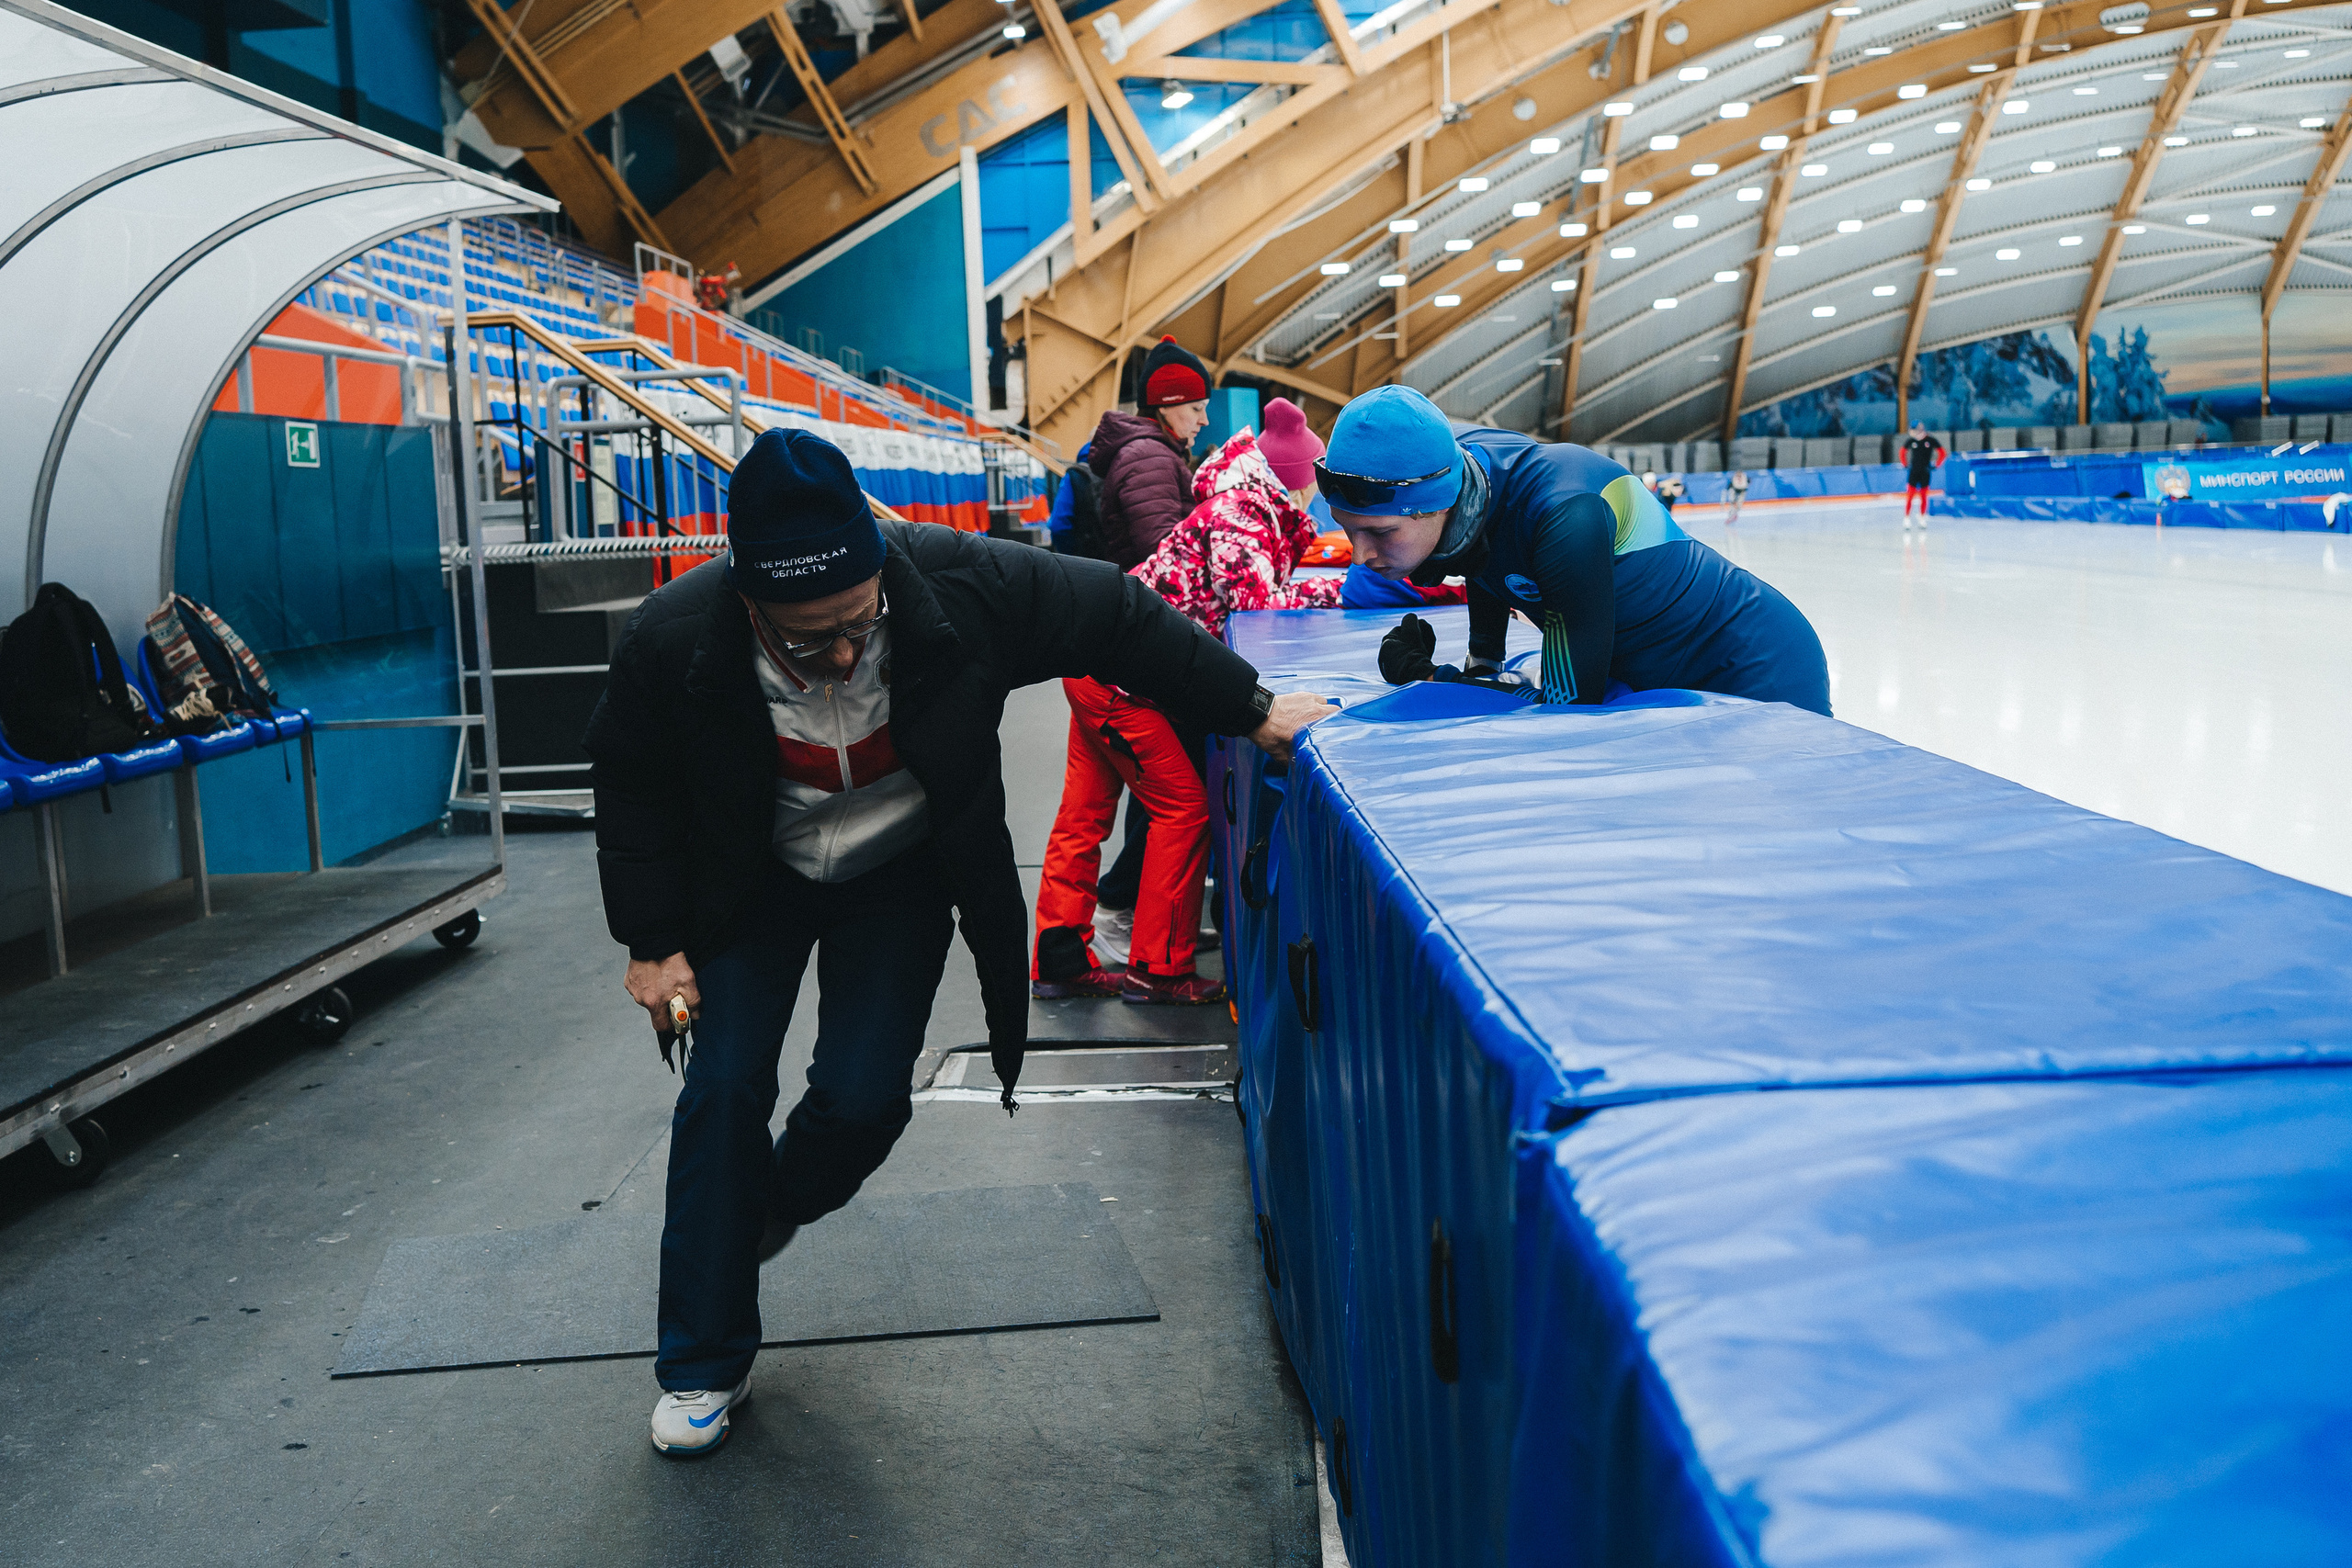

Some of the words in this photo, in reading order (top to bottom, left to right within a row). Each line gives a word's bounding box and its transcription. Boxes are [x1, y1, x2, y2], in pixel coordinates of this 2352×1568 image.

[2199, 470, 2279, 488] МИНСПОРТ
[2283, 467, 2346, 485] РОССИИ
[753, 547, 848, 569] СВЕРДЛОВСКАЯ
[772, 564, 827, 579] ОБЛАСТЬ
